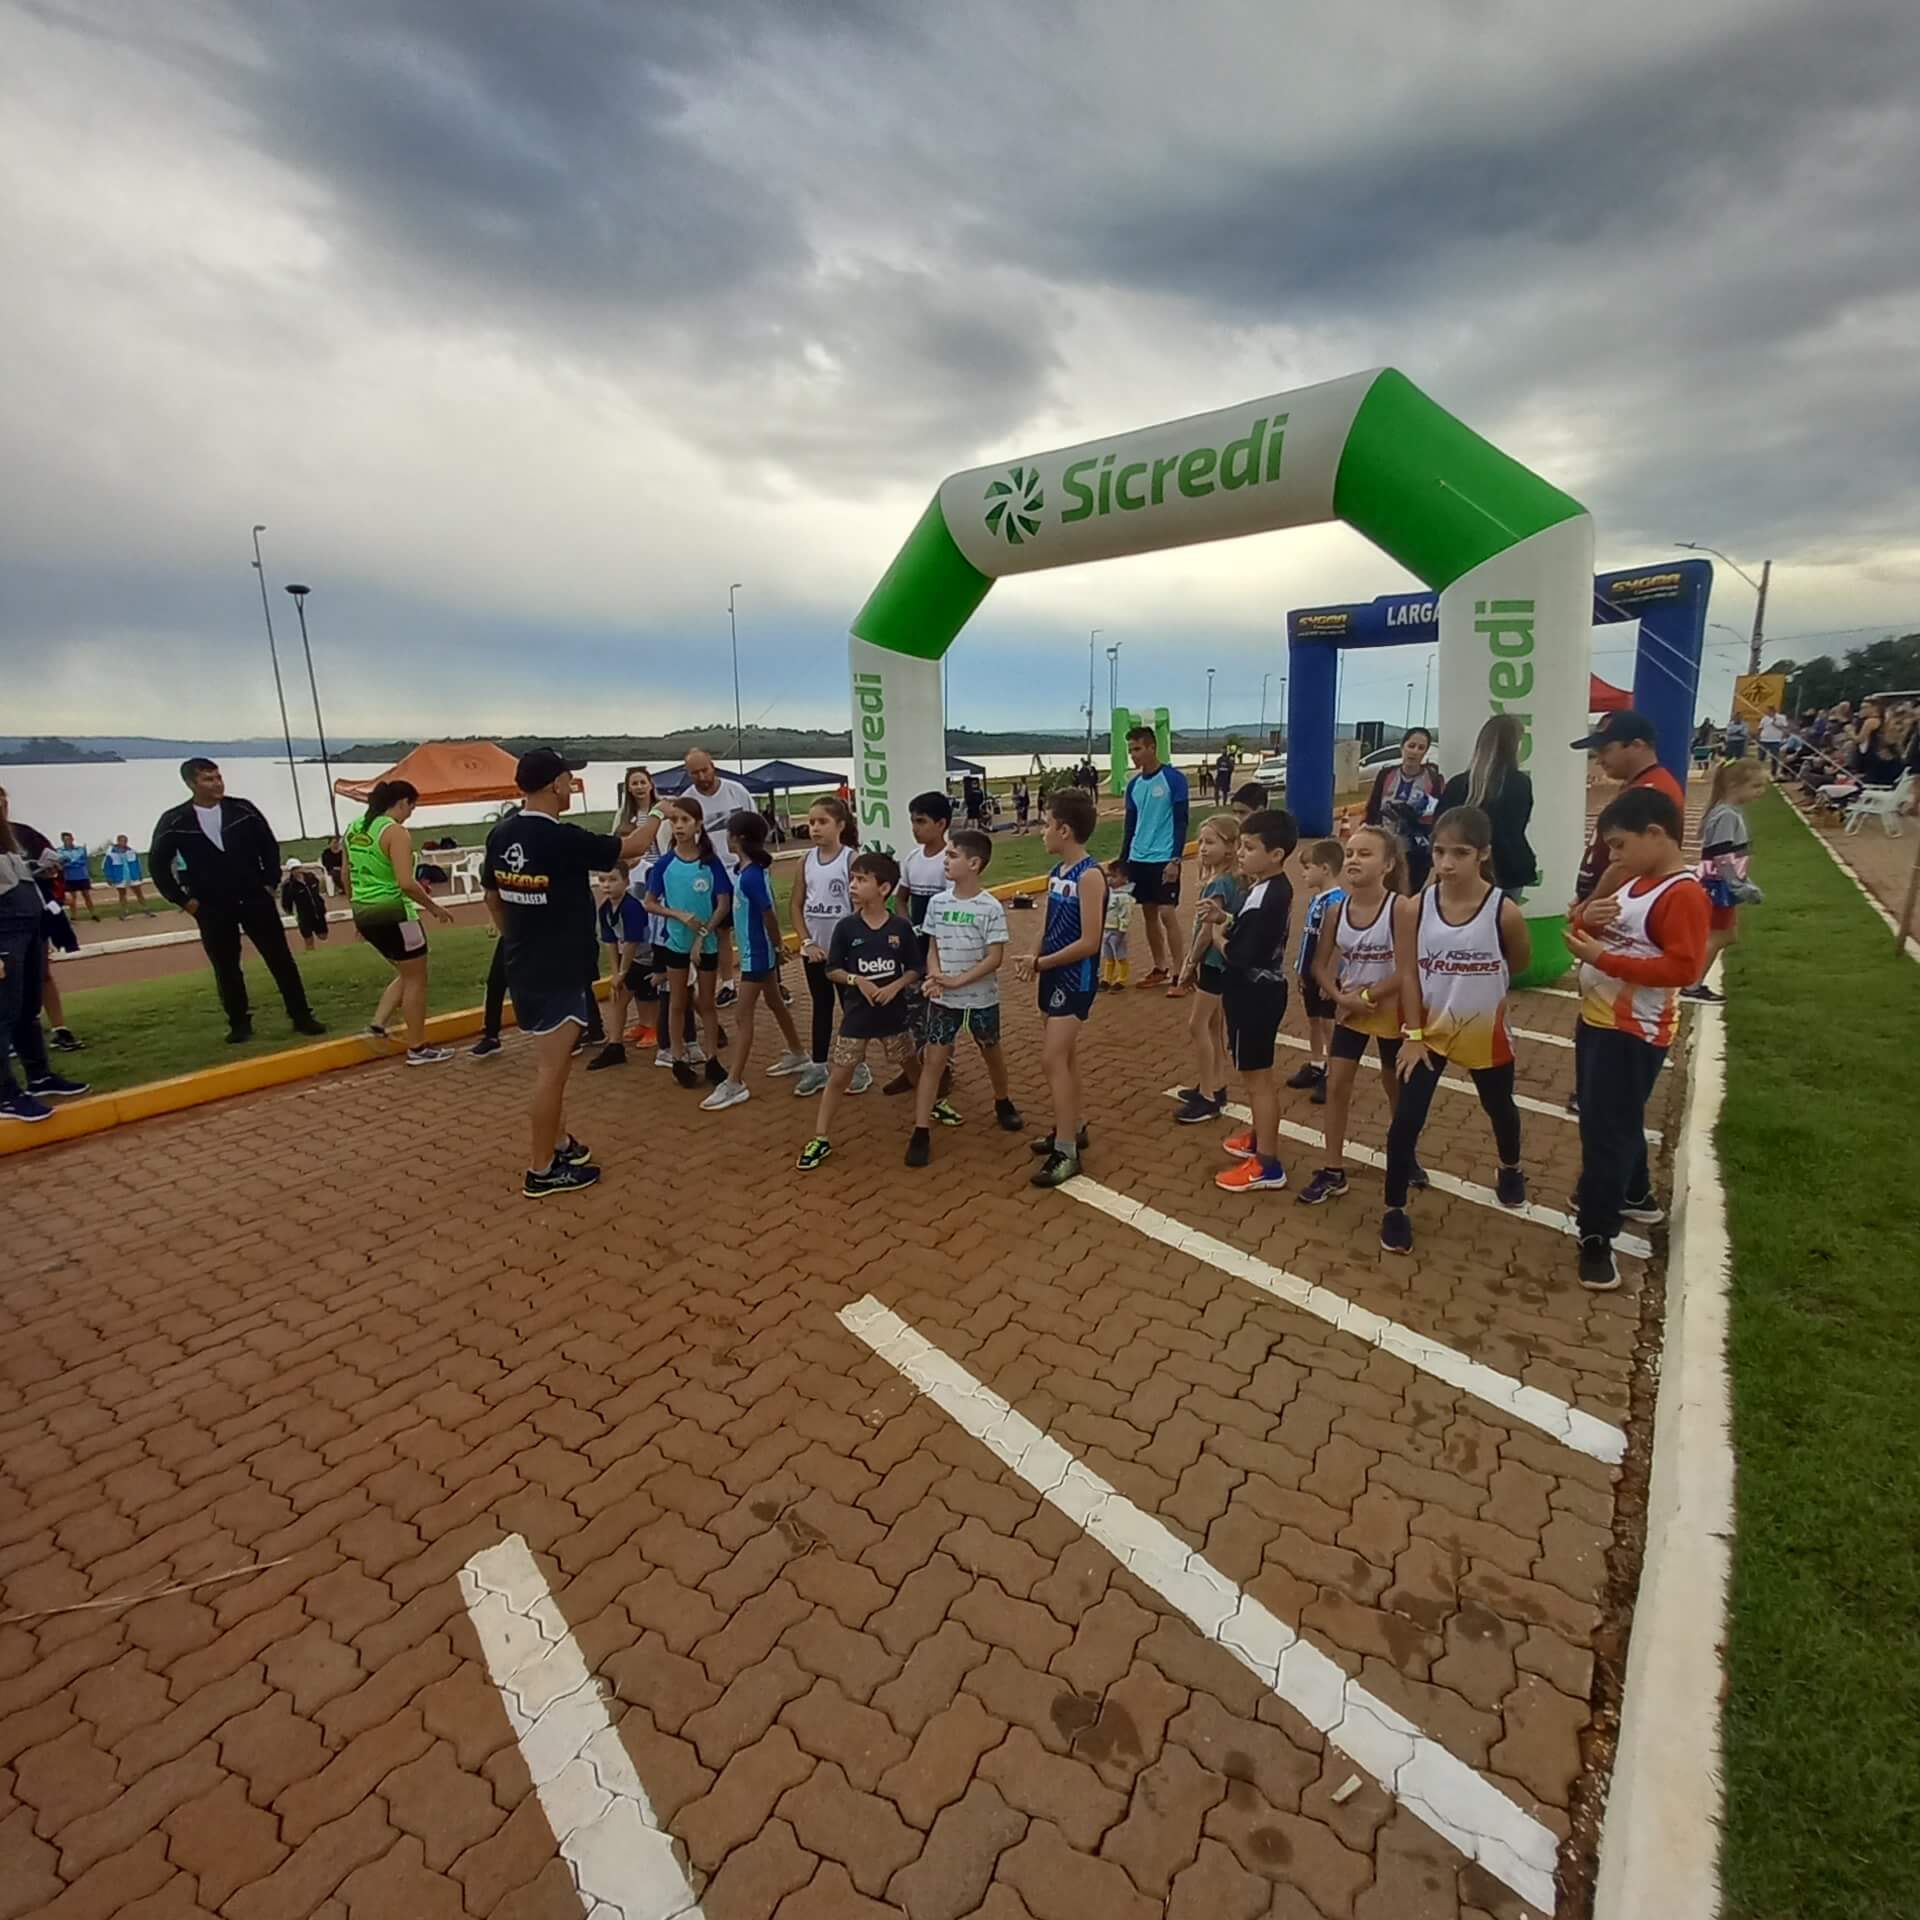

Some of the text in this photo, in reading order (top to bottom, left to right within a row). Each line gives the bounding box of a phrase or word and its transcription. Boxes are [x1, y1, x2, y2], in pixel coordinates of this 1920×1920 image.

[1061, 412, 1290, 523] Sicredi
[854, 672, 891, 829] Sicredi
[858, 957, 896, 973] beko
[1434, 960, 1502, 972] RUNNERS
